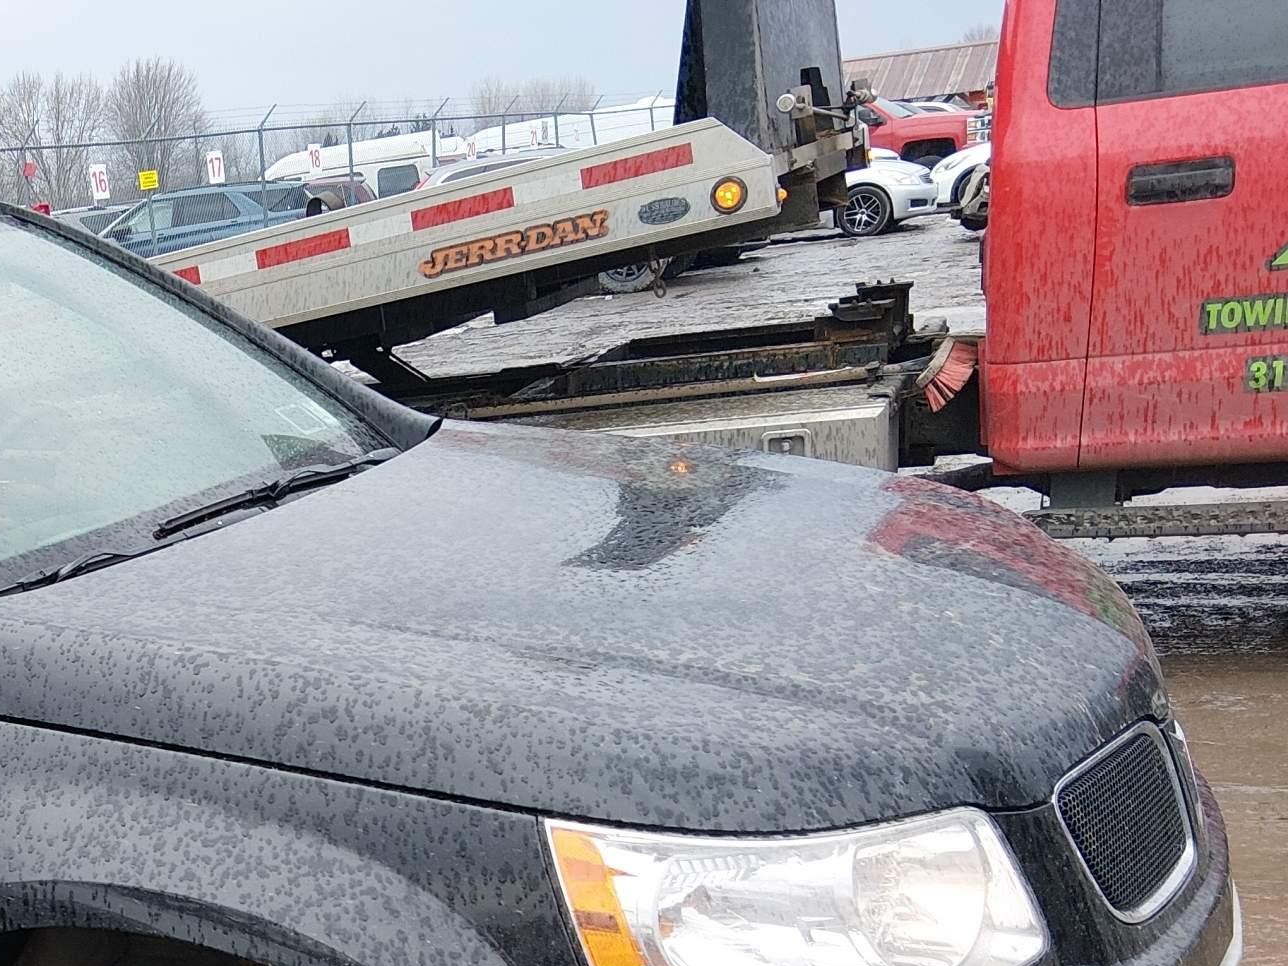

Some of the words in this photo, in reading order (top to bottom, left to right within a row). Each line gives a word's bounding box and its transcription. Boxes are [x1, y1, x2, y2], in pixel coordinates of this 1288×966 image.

[309, 149, 321, 169] 18
[466, 141, 476, 158] 20
[208, 156, 222, 178] 17
[91, 169, 108, 194] 16
[419, 209, 609, 278] JERR-DAN
[1205, 296, 1288, 330] TOWI
[1248, 360, 1285, 389] 31
